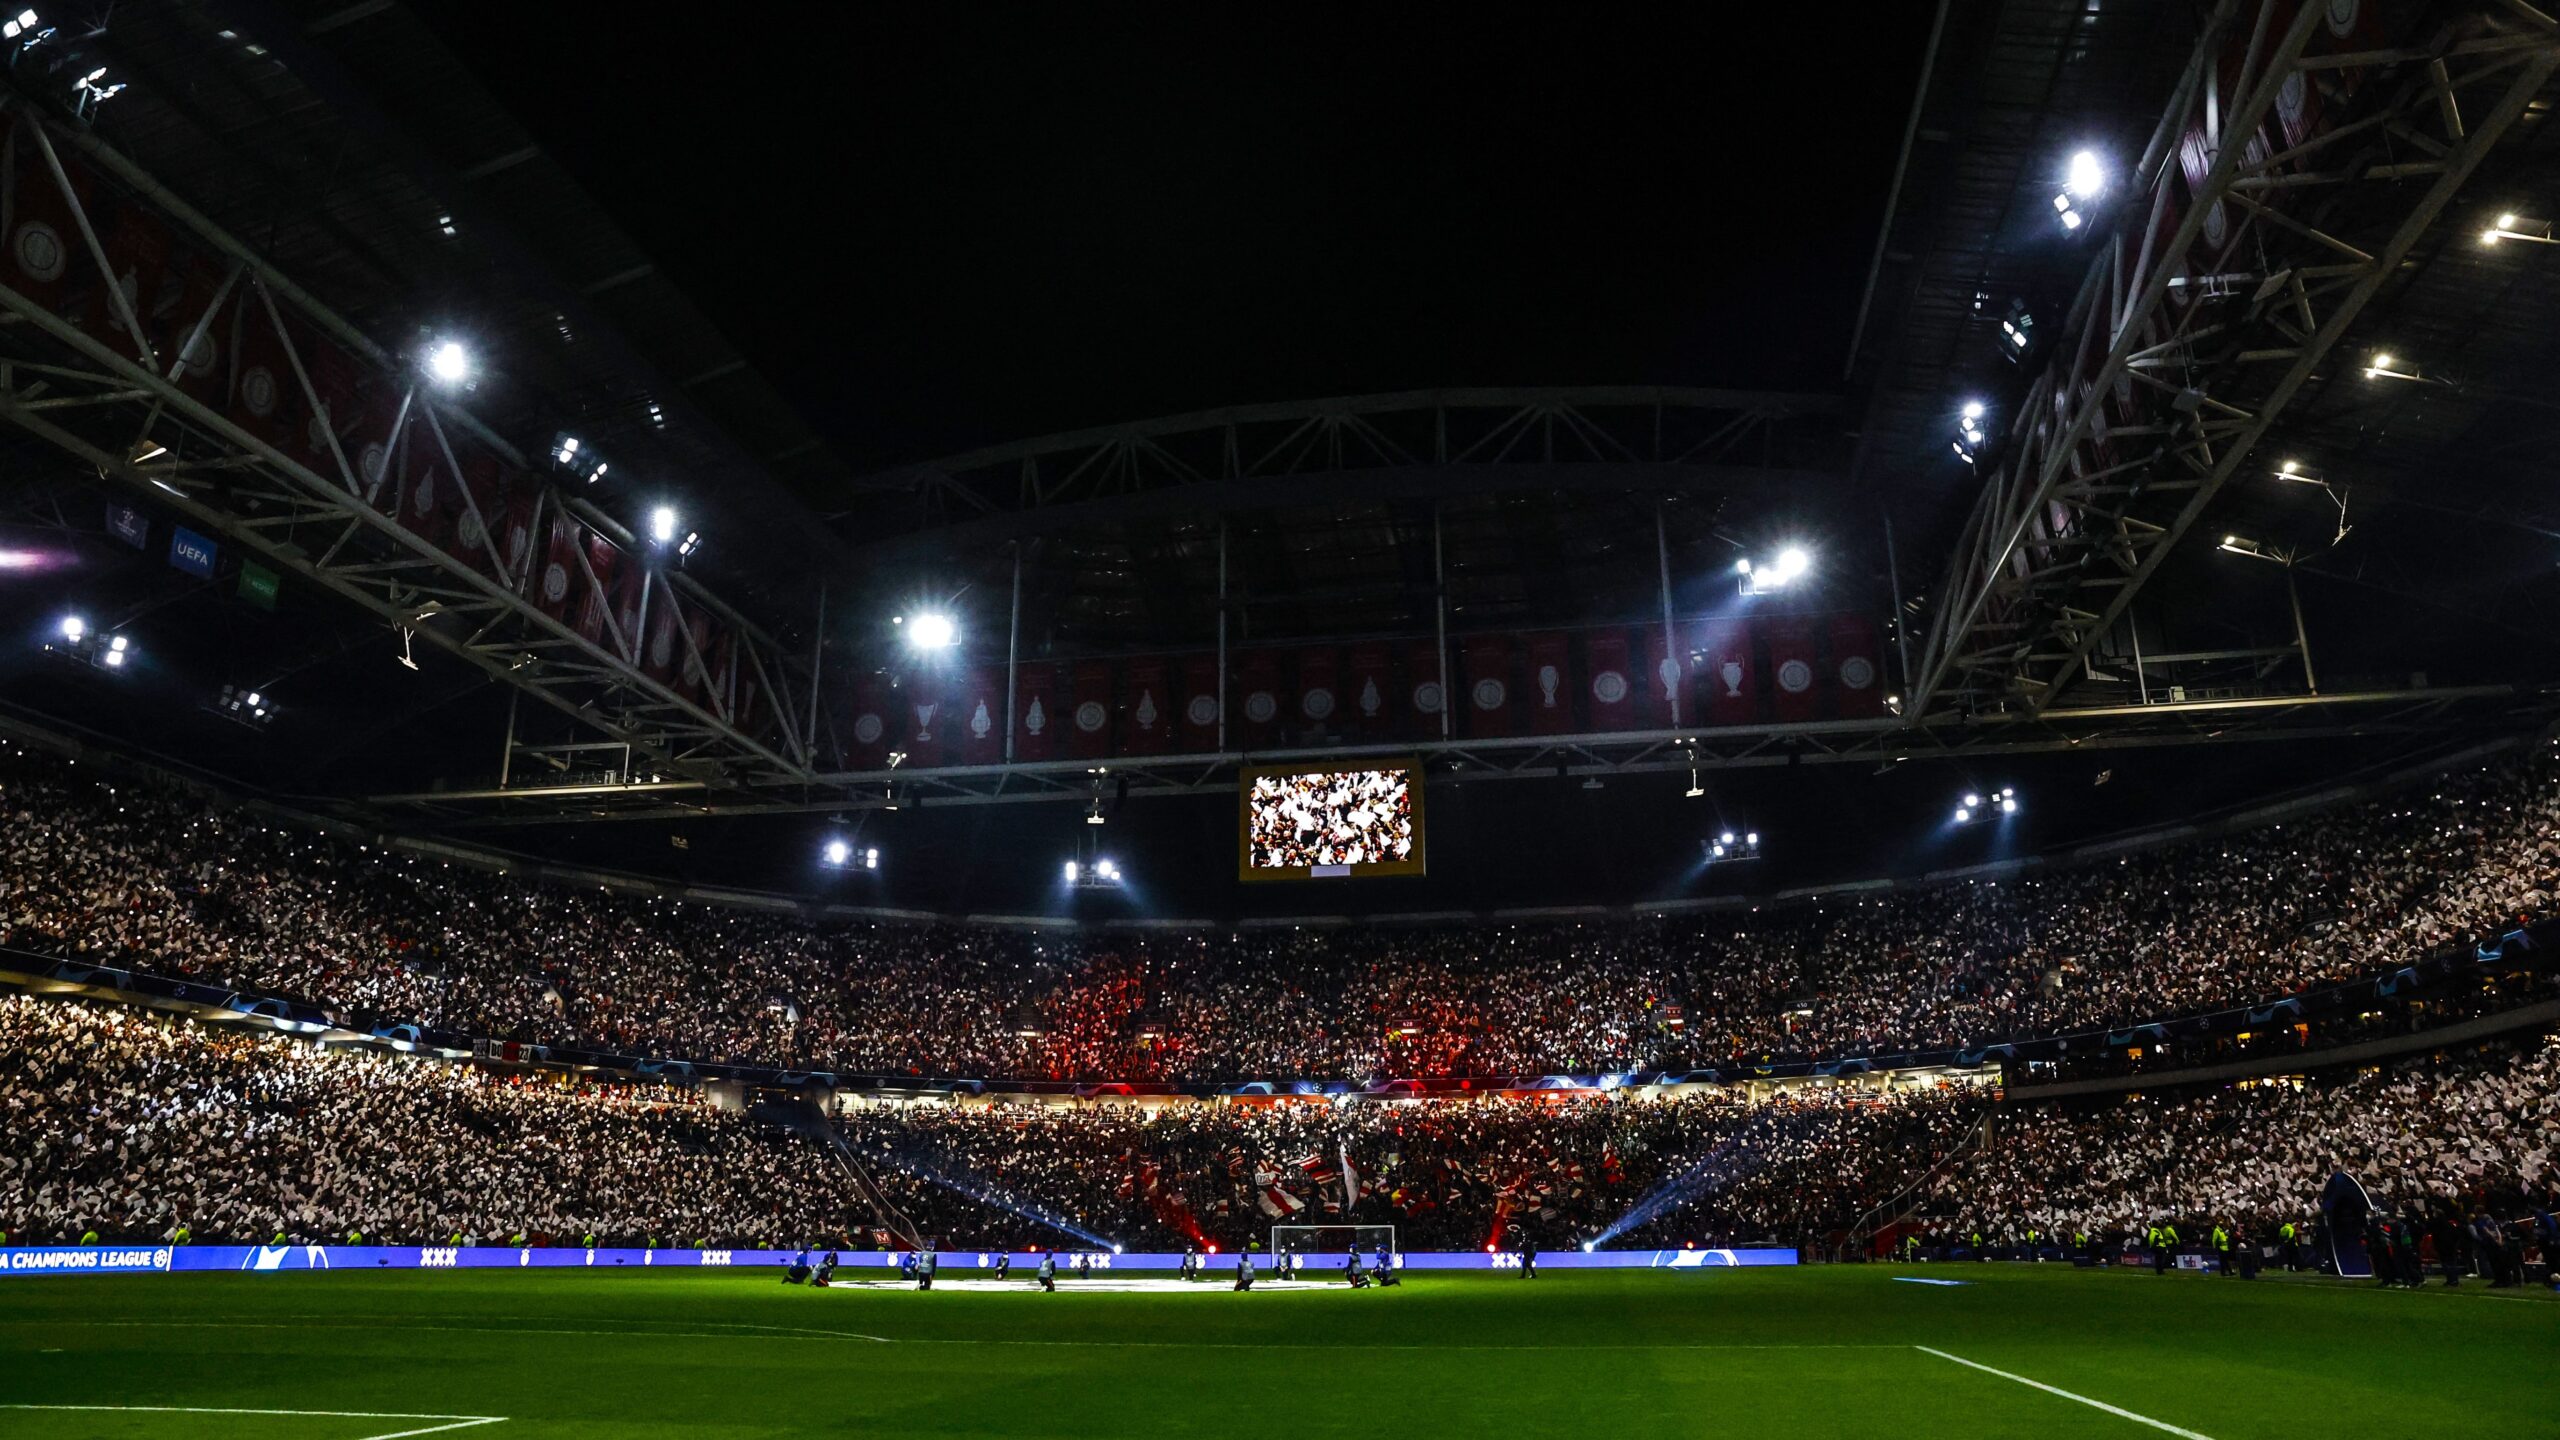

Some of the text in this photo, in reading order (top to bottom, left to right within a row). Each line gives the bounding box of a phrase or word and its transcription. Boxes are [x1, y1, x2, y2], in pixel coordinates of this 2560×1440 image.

[177, 543, 208, 566] UEFA
[0, 1251, 152, 1269] A CHAMPIONS LEAGUE
